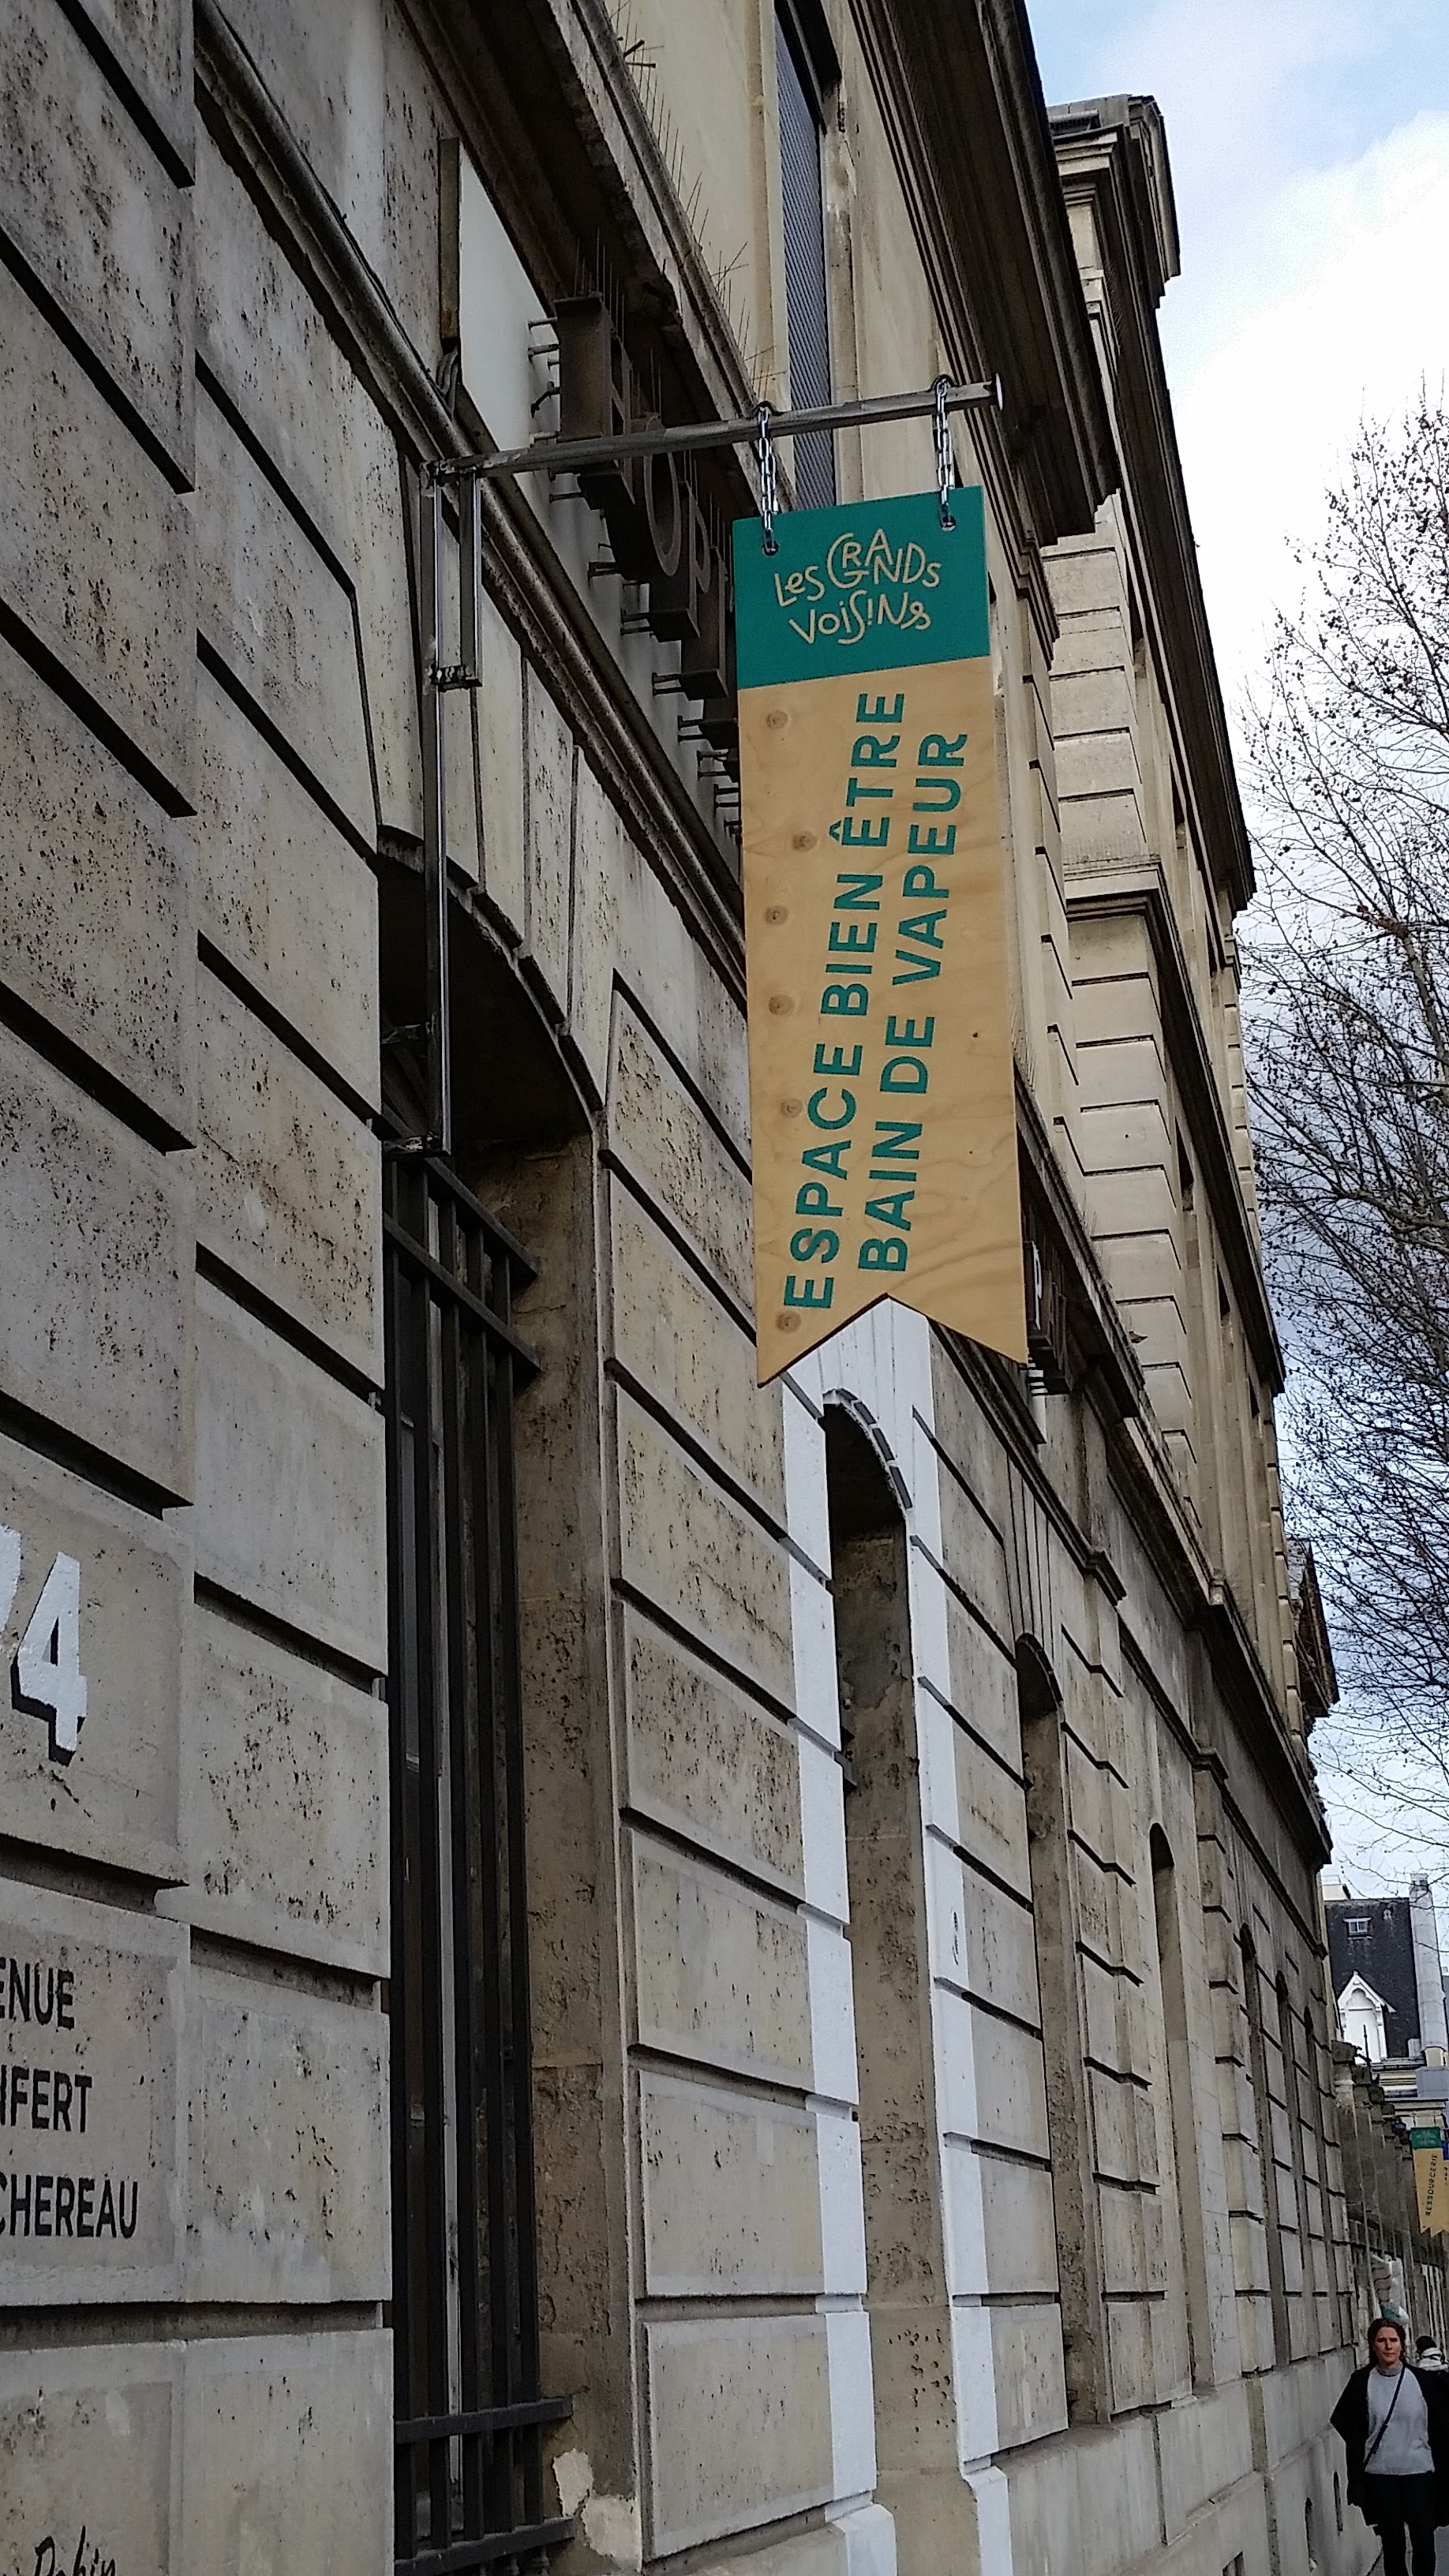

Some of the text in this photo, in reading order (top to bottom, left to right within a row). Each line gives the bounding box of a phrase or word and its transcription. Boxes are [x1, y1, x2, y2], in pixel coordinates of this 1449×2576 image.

[783, 693, 904, 1309] ESPACE BIEN ÊTRE
[858, 733, 968, 1271] BAIN DE VAPEUR
[0, 2065, 92, 2132] FERT
